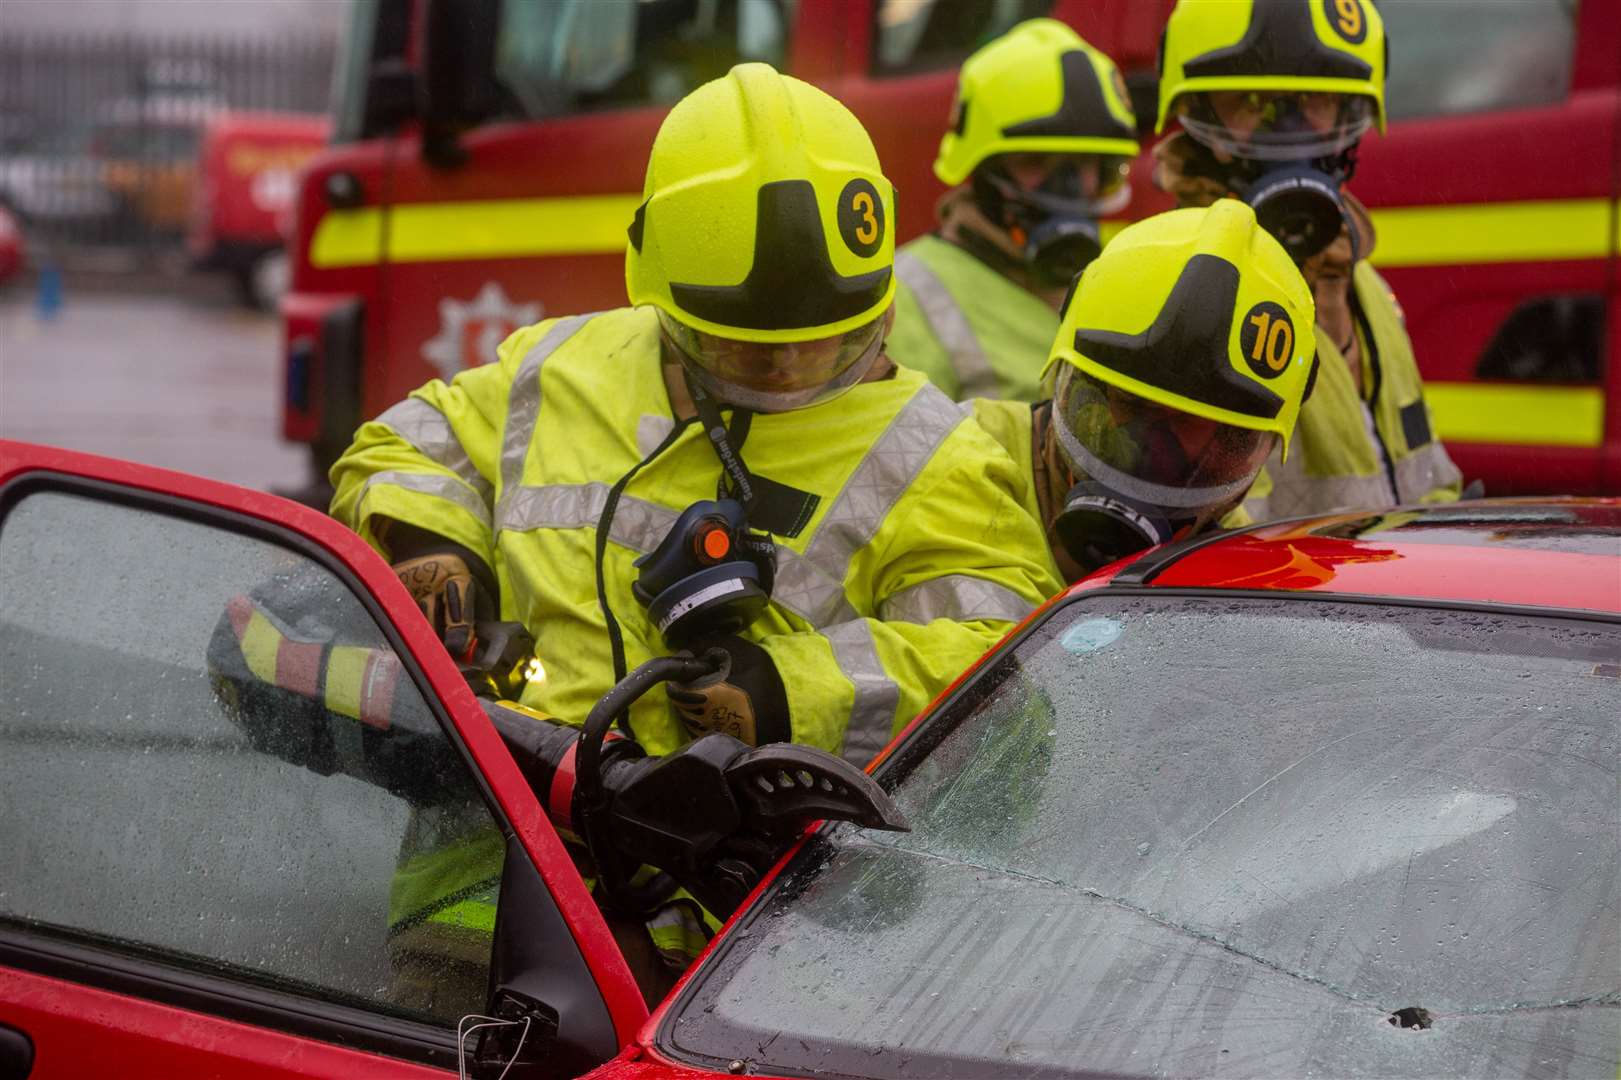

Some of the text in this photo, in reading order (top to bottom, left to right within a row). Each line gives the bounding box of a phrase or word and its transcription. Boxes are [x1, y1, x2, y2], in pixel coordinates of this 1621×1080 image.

[1335, 0, 1361, 36] 9
[852, 191, 878, 245] 3
[1250, 311, 1292, 371] 10
[718, 440, 753, 502] Sundström
